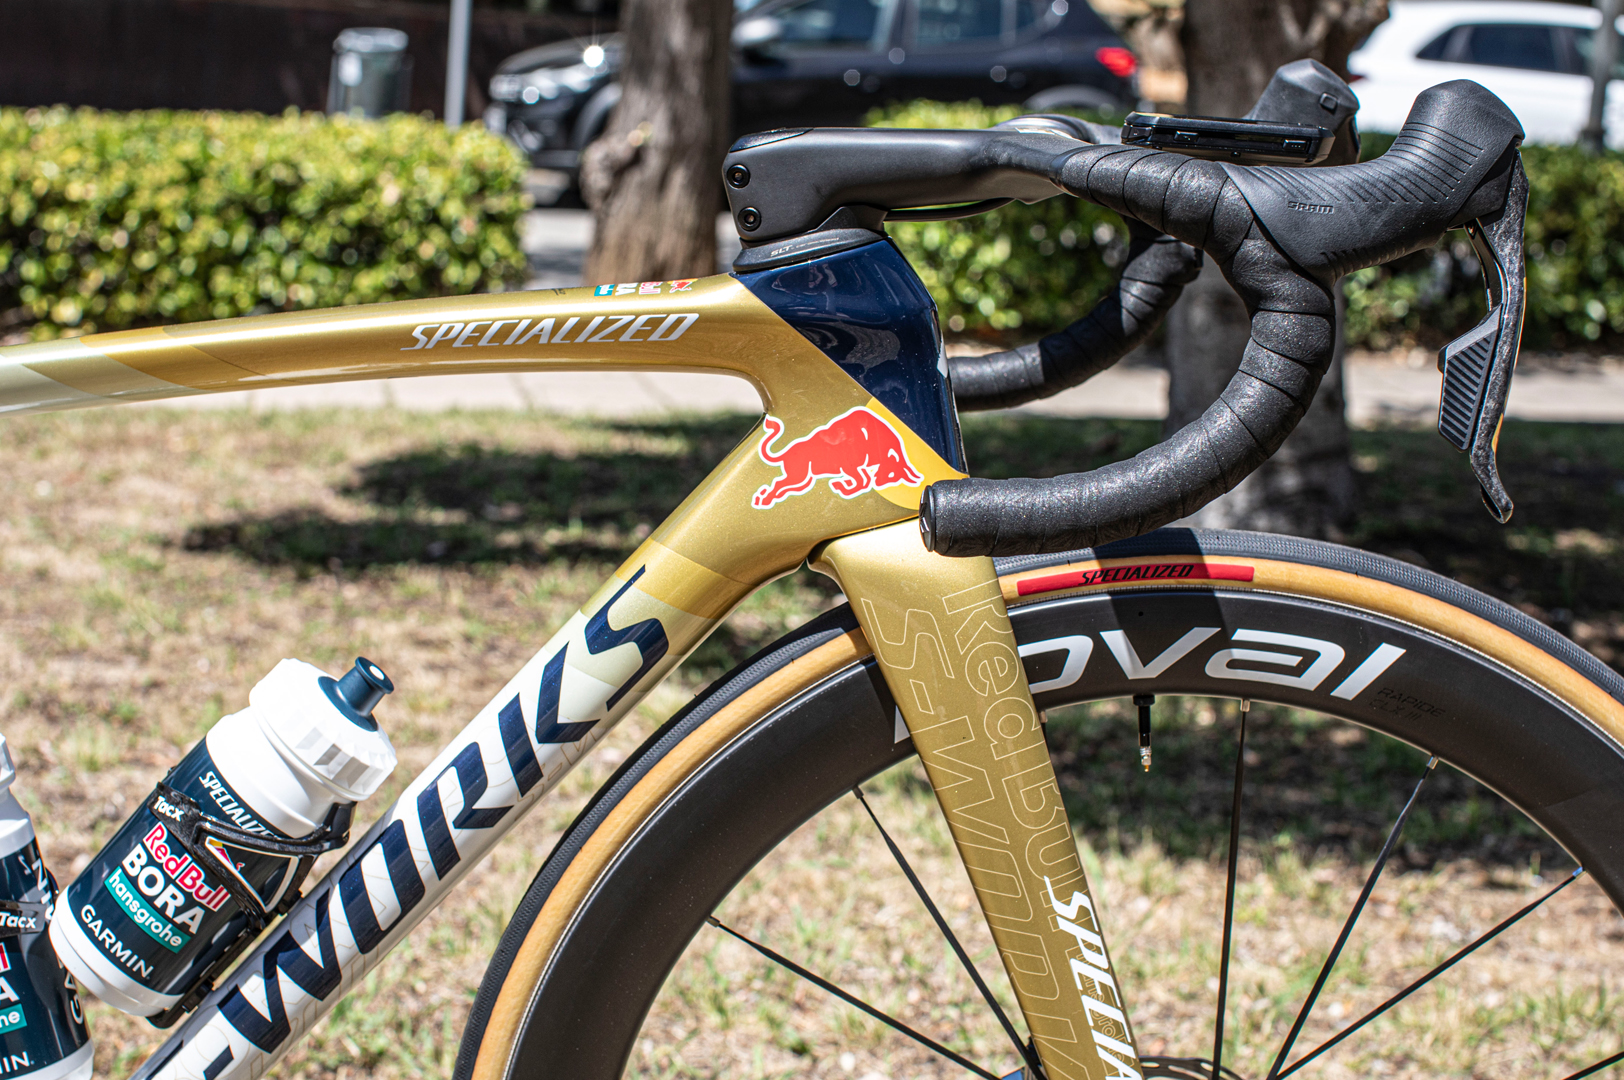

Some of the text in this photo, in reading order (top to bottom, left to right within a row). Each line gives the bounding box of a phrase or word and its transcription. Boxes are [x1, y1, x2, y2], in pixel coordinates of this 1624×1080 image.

[1287, 201, 1335, 214] SRAM
[400, 313, 699, 351] SPECIALIZED
[1078, 563, 1195, 587] SPECIALIZED
[1017, 626, 1407, 700] oval
[1377, 687, 1447, 718] RAPIDE
[145, 564, 669, 1080] -WORKS
[153, 795, 185, 822] Tacx
[199, 770, 275, 837] SPECIALIZ
[0, 911, 37, 929] Tacx
[108, 869, 183, 947] hansgrohe
[122, 843, 205, 934] BORA
[81, 904, 154, 978] GARMIN
[1043, 875, 1143, 1080] SPECIA
